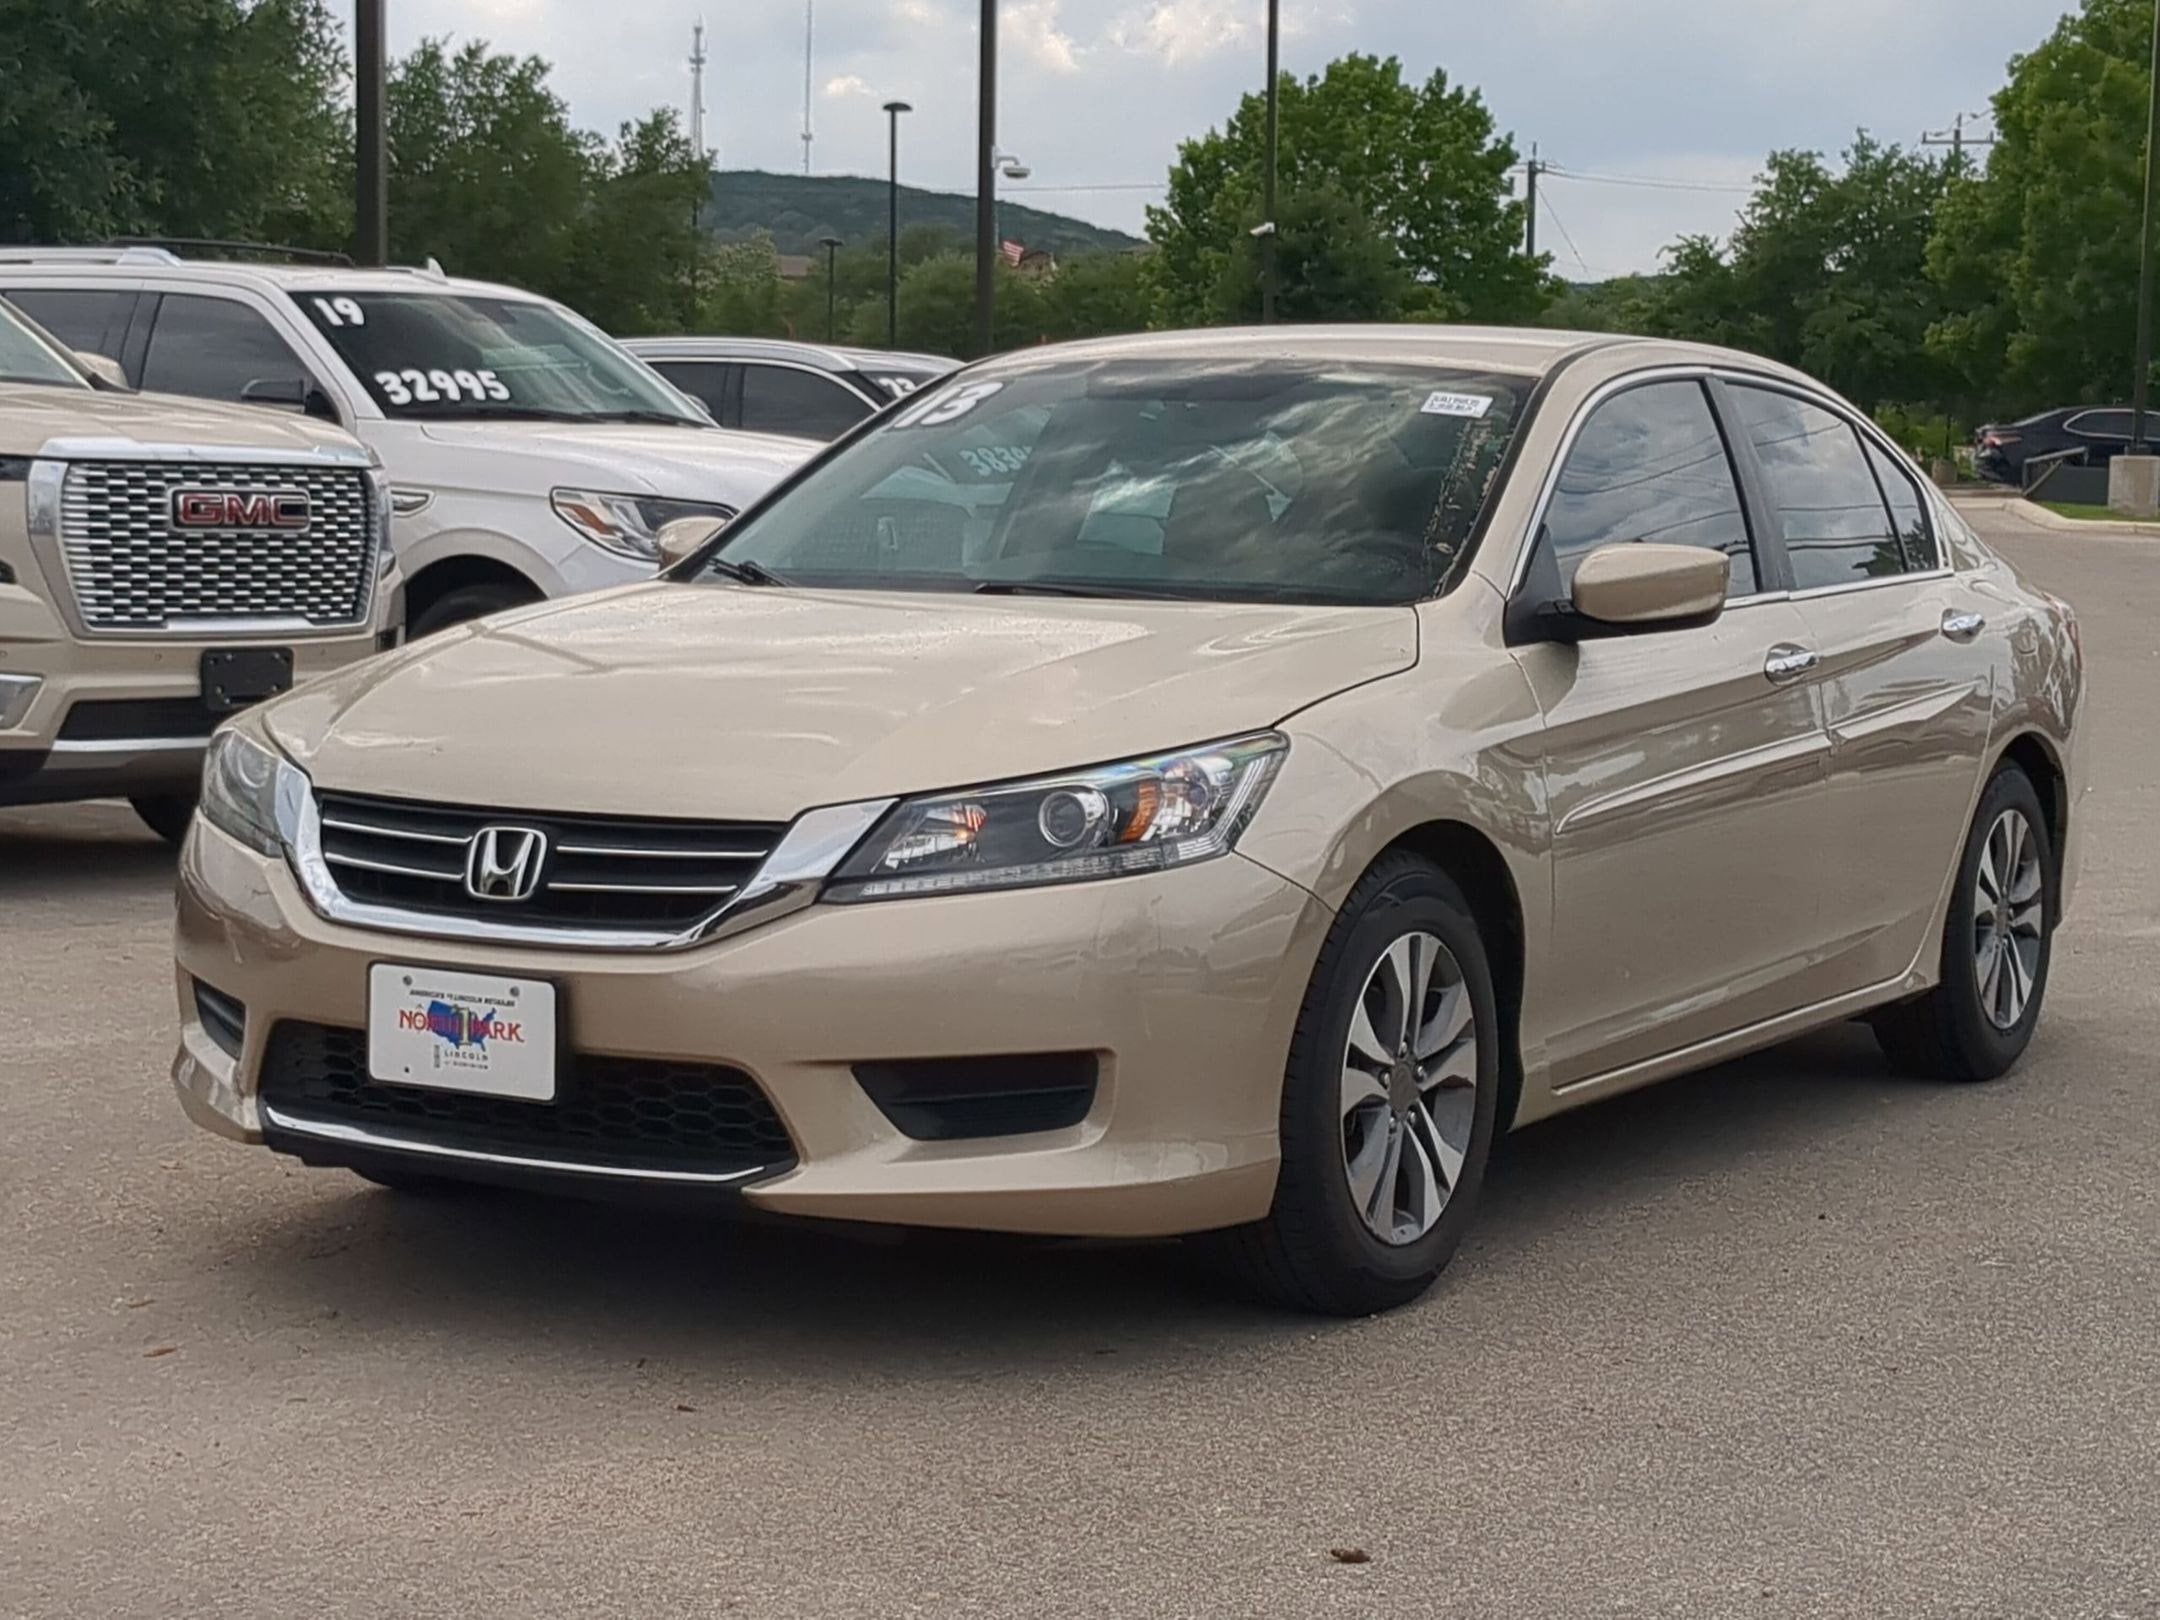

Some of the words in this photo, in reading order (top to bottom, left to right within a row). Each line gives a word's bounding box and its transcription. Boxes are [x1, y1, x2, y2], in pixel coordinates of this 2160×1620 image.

[314, 297, 364, 326] 19
[374, 369, 510, 405] 32995
[894, 381, 1004, 429] 13
[178, 493, 309, 526] GMC
[444, 1050, 489, 1061] LINCOLN
